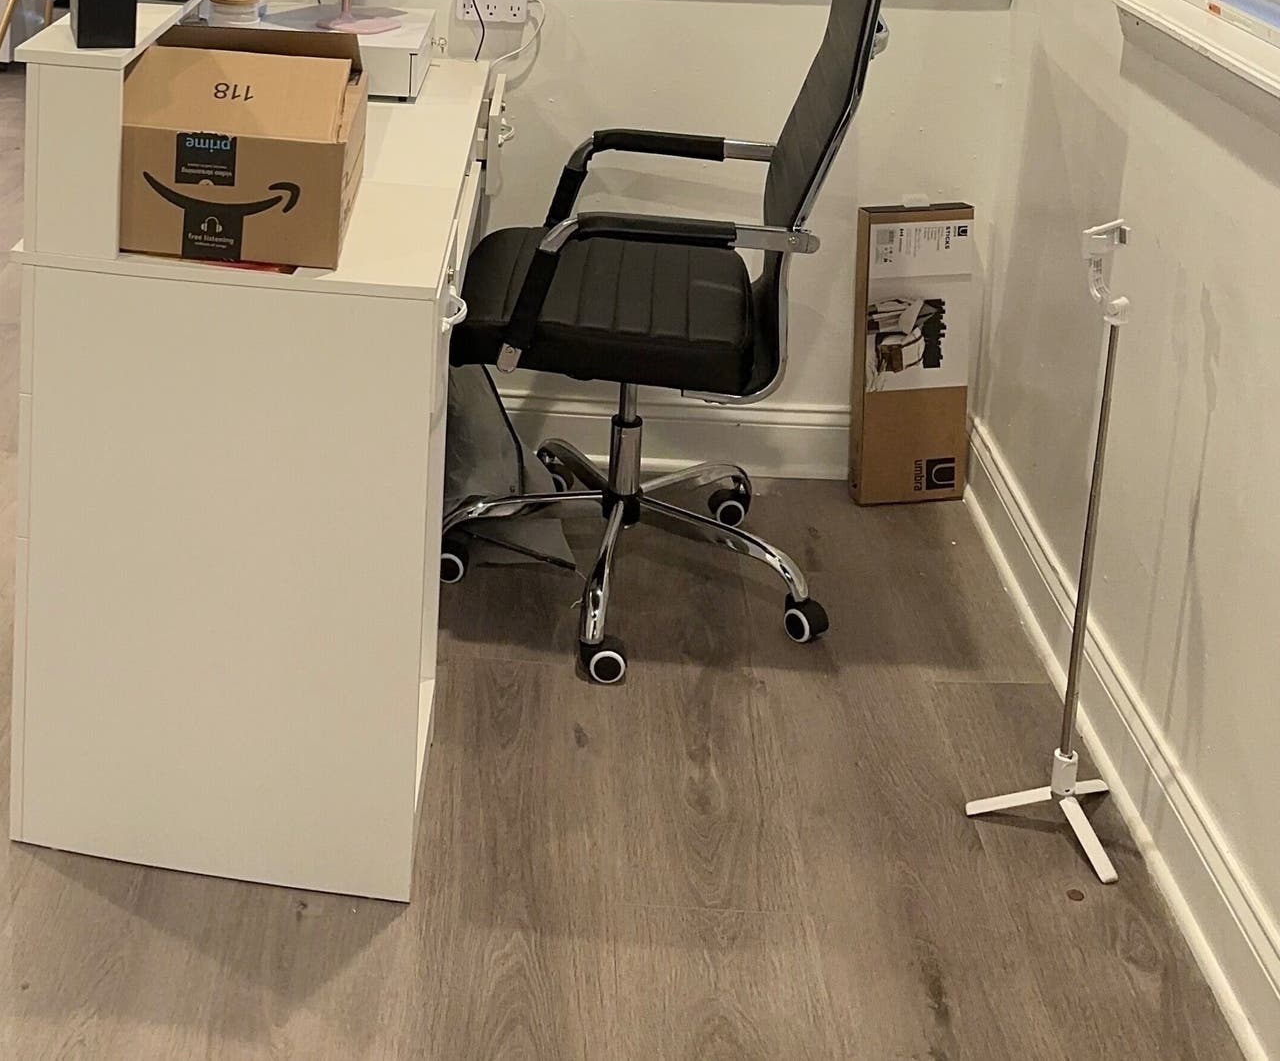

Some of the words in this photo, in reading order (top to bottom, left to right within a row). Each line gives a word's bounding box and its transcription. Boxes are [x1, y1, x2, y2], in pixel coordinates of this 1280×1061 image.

[213, 82, 254, 102] 118
[185, 136, 231, 153] prime
[187, 232, 203, 241] free
[203, 234, 235, 246] listening
[913, 458, 925, 492] umbra
